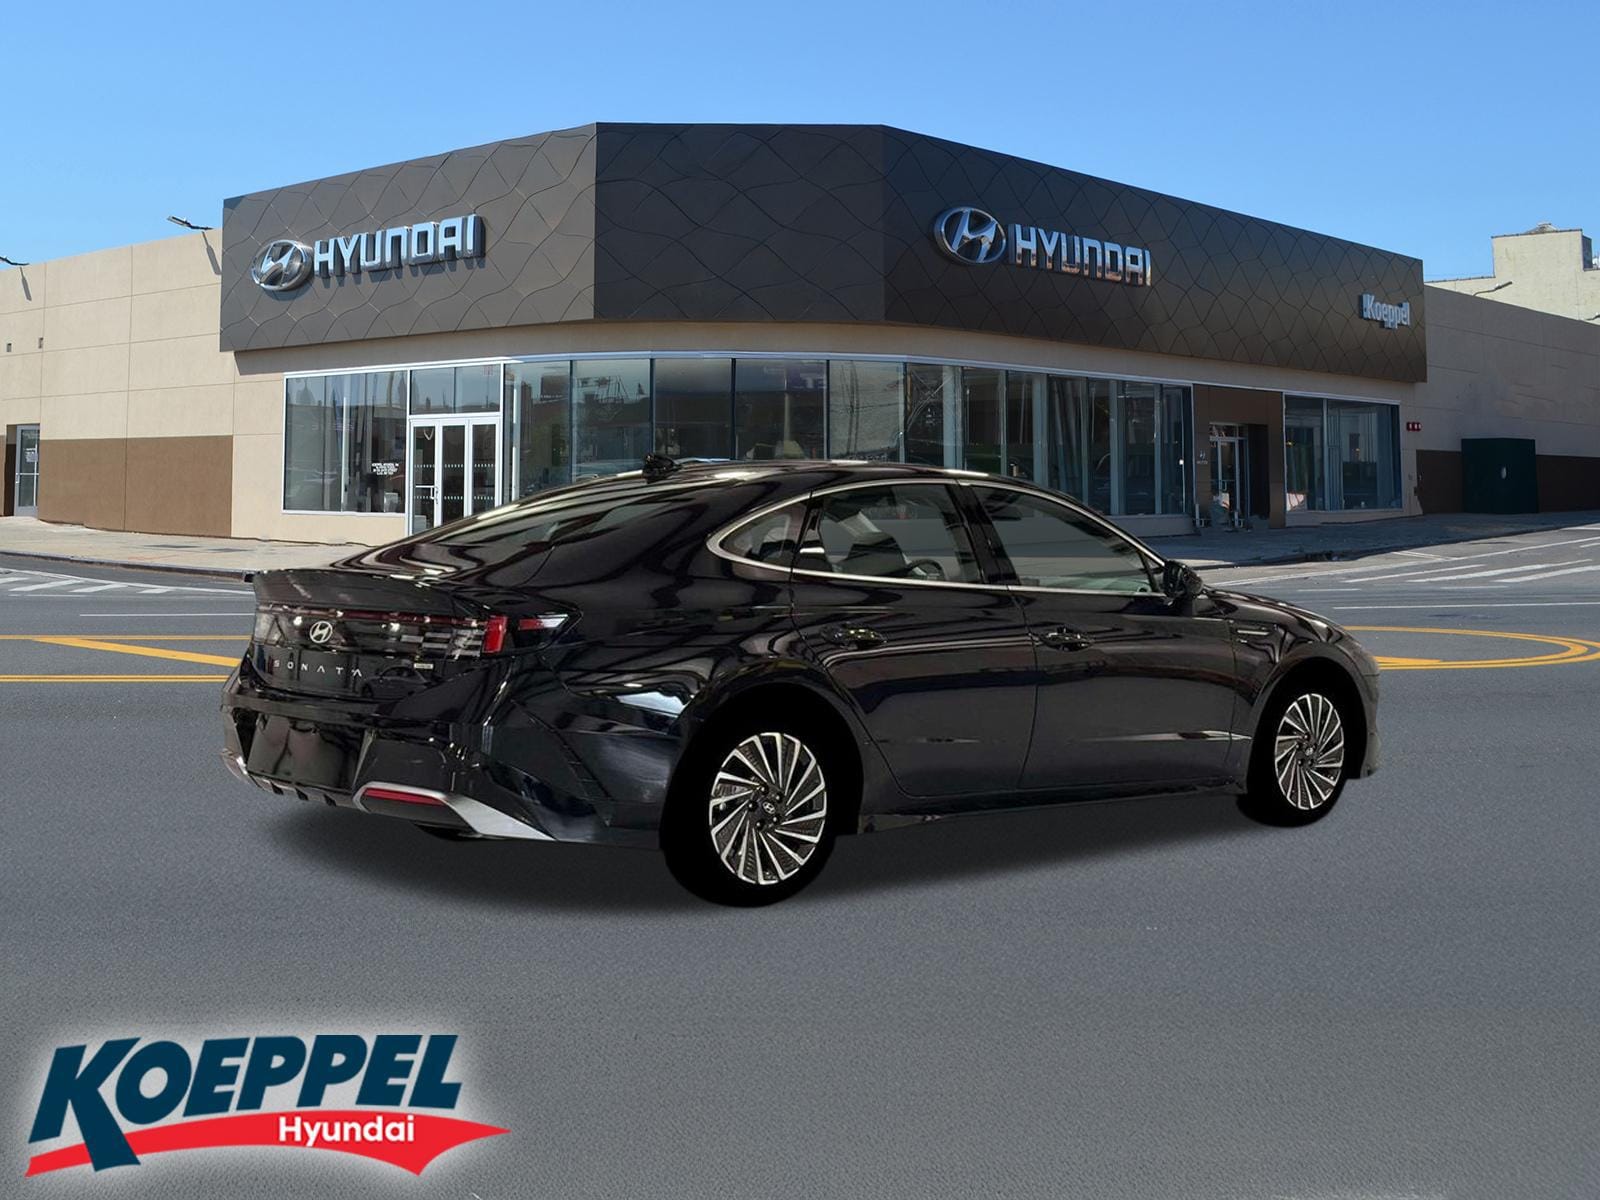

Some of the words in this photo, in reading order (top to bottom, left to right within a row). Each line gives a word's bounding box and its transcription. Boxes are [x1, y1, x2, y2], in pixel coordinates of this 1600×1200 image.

[313, 213, 486, 278] HYUNDAI
[1008, 223, 1152, 287] HYUNDAI
[1360, 293, 1410, 330] Koeppel
[273, 659, 362, 678] SONATA
